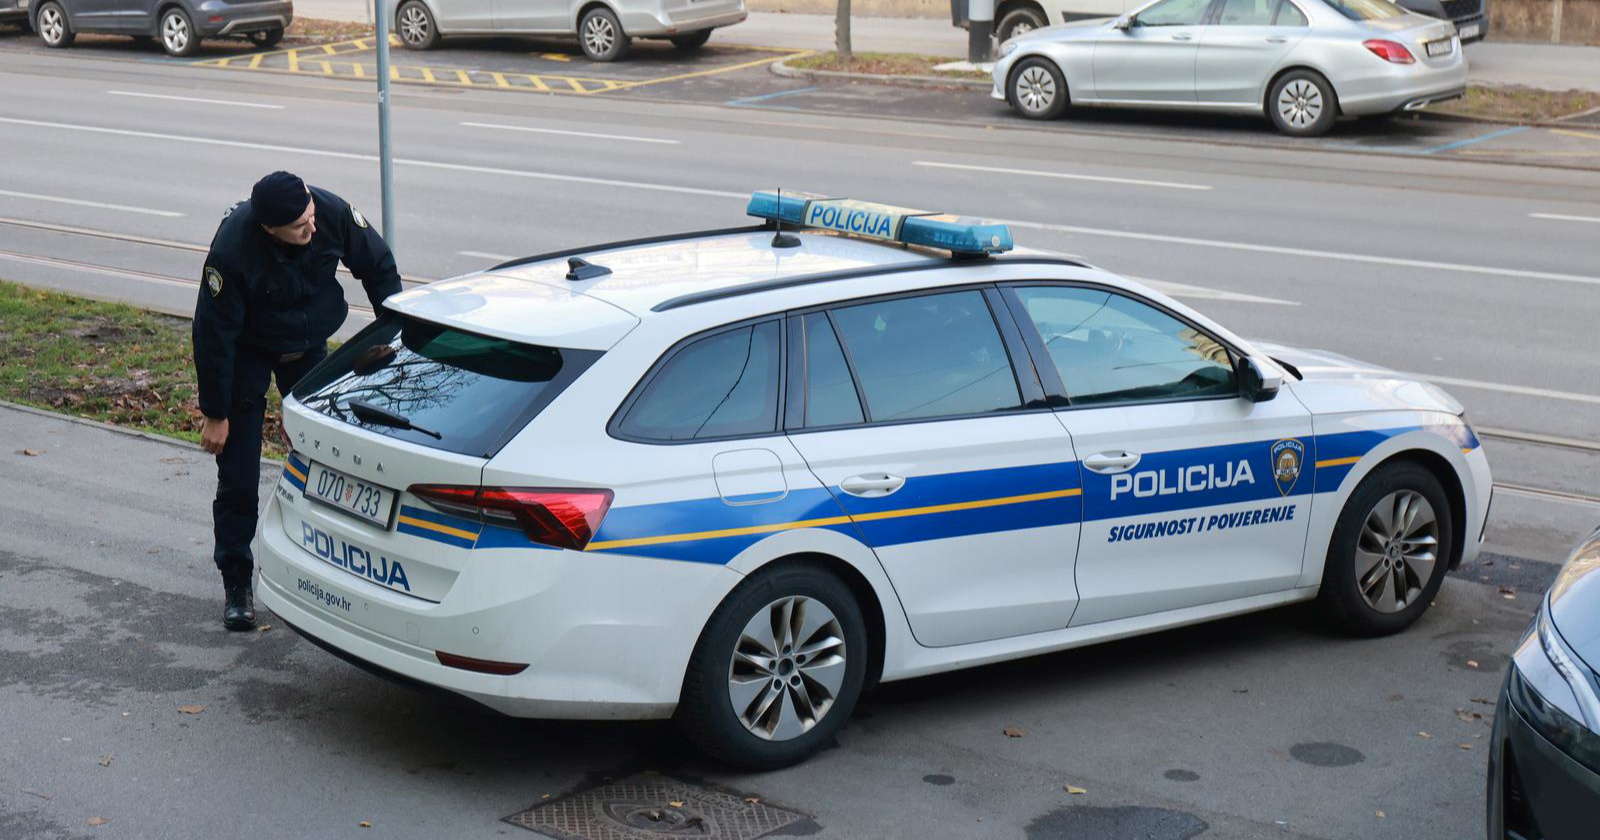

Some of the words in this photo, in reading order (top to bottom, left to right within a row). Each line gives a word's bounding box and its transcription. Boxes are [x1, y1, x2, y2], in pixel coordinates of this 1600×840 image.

[810, 204, 891, 236] POLICIJA
[1274, 441, 1302, 453] POLICIJA
[317, 469, 345, 502] 070
[352, 482, 381, 516] 733
[1111, 459, 1255, 501] POLICIJA
[1108, 517, 1197, 543] SIGURNOST
[1198, 516, 1205, 532] I
[1207, 504, 1296, 531] POVJERENJE
[302, 520, 411, 592] POLICIJA
[297, 577, 352, 612] policija.gov.hr
